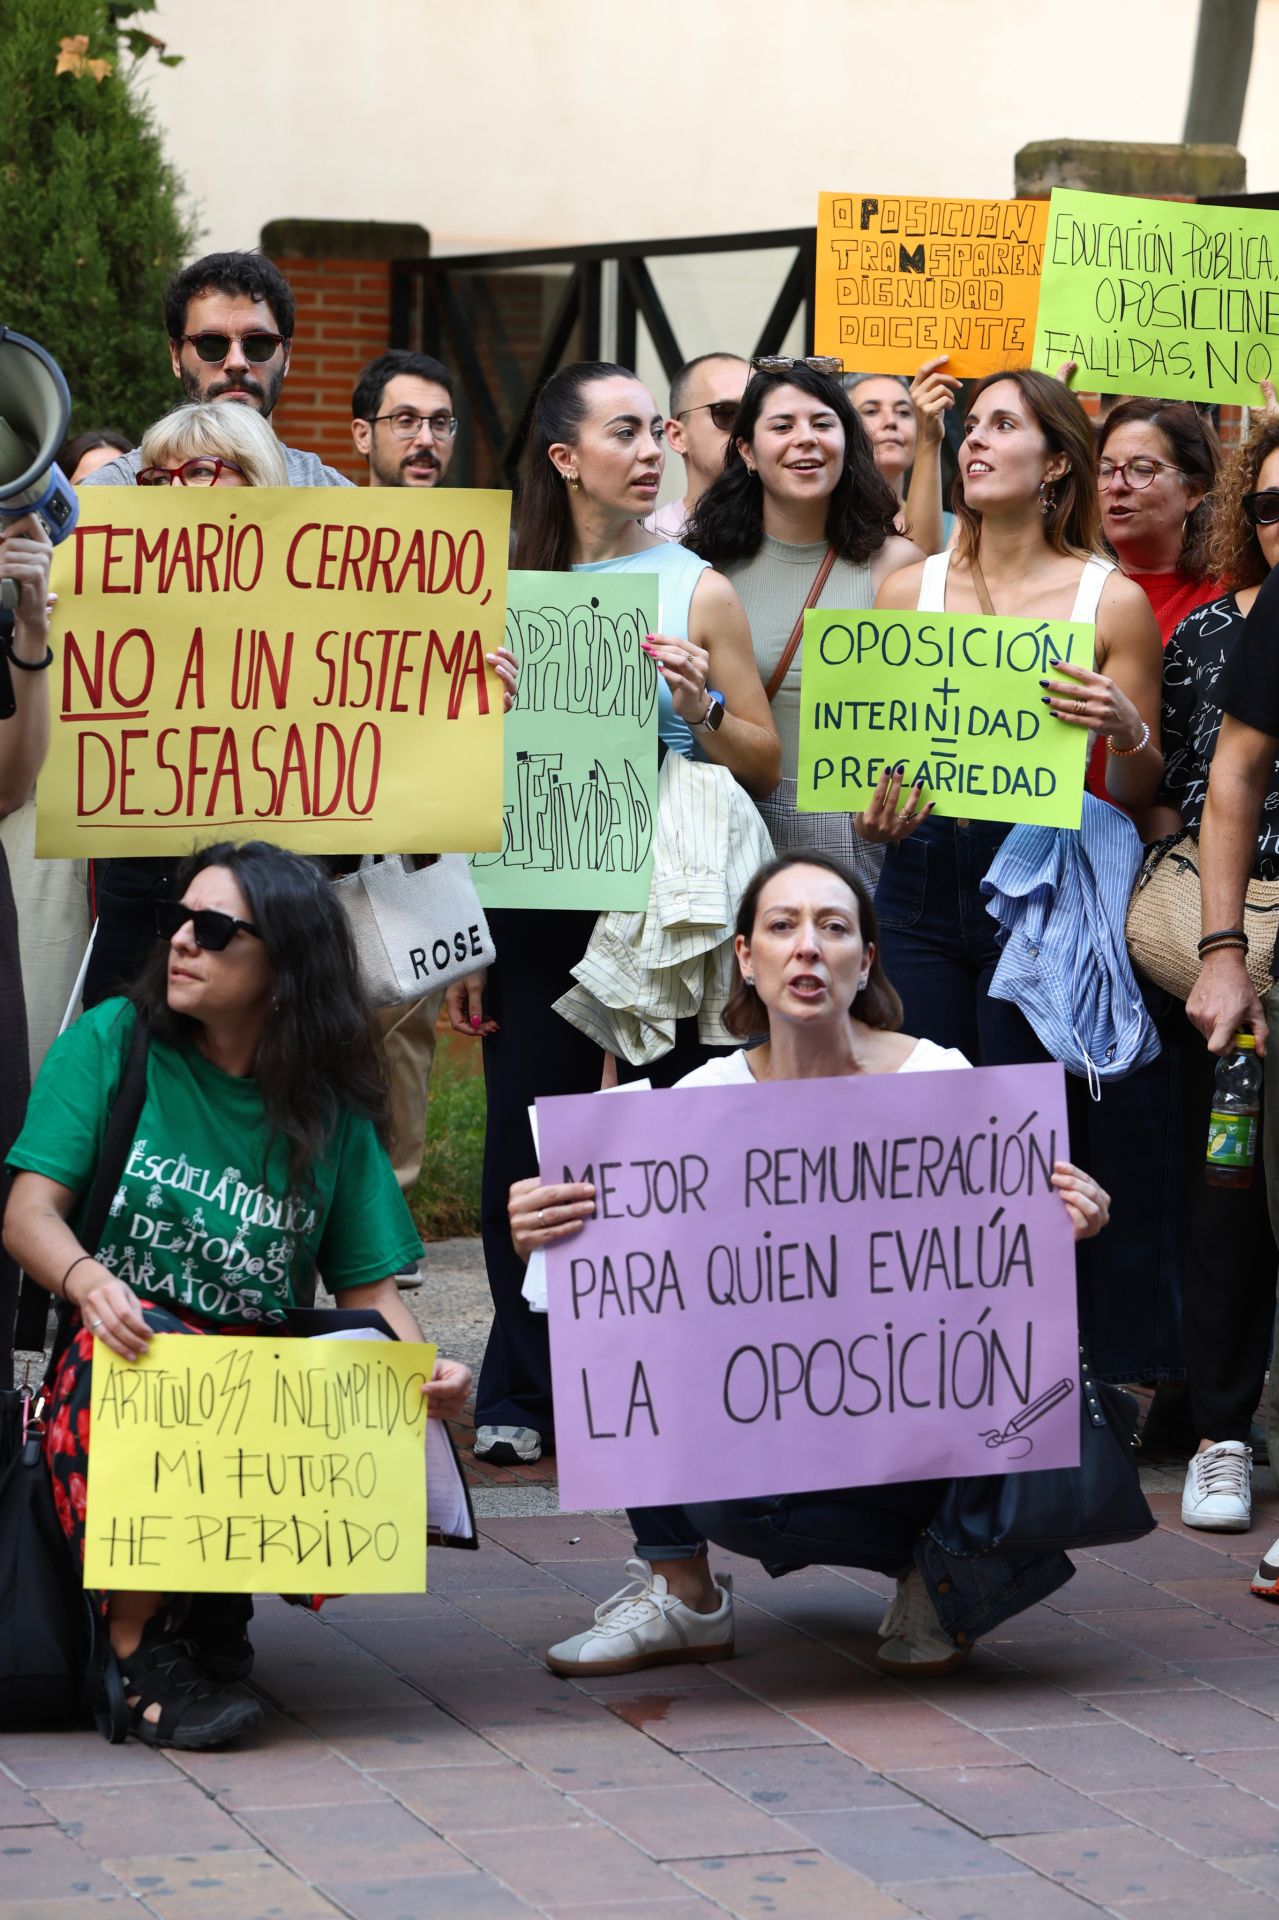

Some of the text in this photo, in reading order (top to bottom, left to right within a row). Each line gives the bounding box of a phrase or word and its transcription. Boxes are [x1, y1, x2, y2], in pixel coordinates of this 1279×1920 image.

[832, 198, 1036, 244] OPOSICIÓN
[1052, 213, 1279, 281] EDUCACIÓN PÚBLICA,
[836, 274, 1004, 311] DIGNIDAD
[1096, 277, 1279, 336] OPOSICIONE
[839, 316, 1026, 351] DOCENTE
[1044, 330, 1272, 389] FALLIDAS, NO
[75, 513, 492, 605] TEMARIO CERRADO,
[62, 627, 490, 720] NO A UN SISTEMA
[820, 622, 1074, 673] OPOSICIÓN
[815, 700, 1040, 741] INTERINIDAD
[77, 722, 382, 817] DESFASADO
[813, 756, 1057, 797] PRECARIEDAD
[409, 924, 483, 979] ROSE
[125, 1150, 227, 1210] ESCUELA
[563, 1110, 1055, 1220] MEJOR REMUNERACIÓN
[129, 1213, 174, 1250] DE
[570, 1207, 1034, 1320] PARA QUIEN EVALÚA
[582, 1307, 1033, 1439] LA OPOSICIÓN
[154, 1441, 205, 1494] MI
[224, 1448, 377, 1499] FUTURO
[100, 1509, 399, 1567] HE PERDIDO
